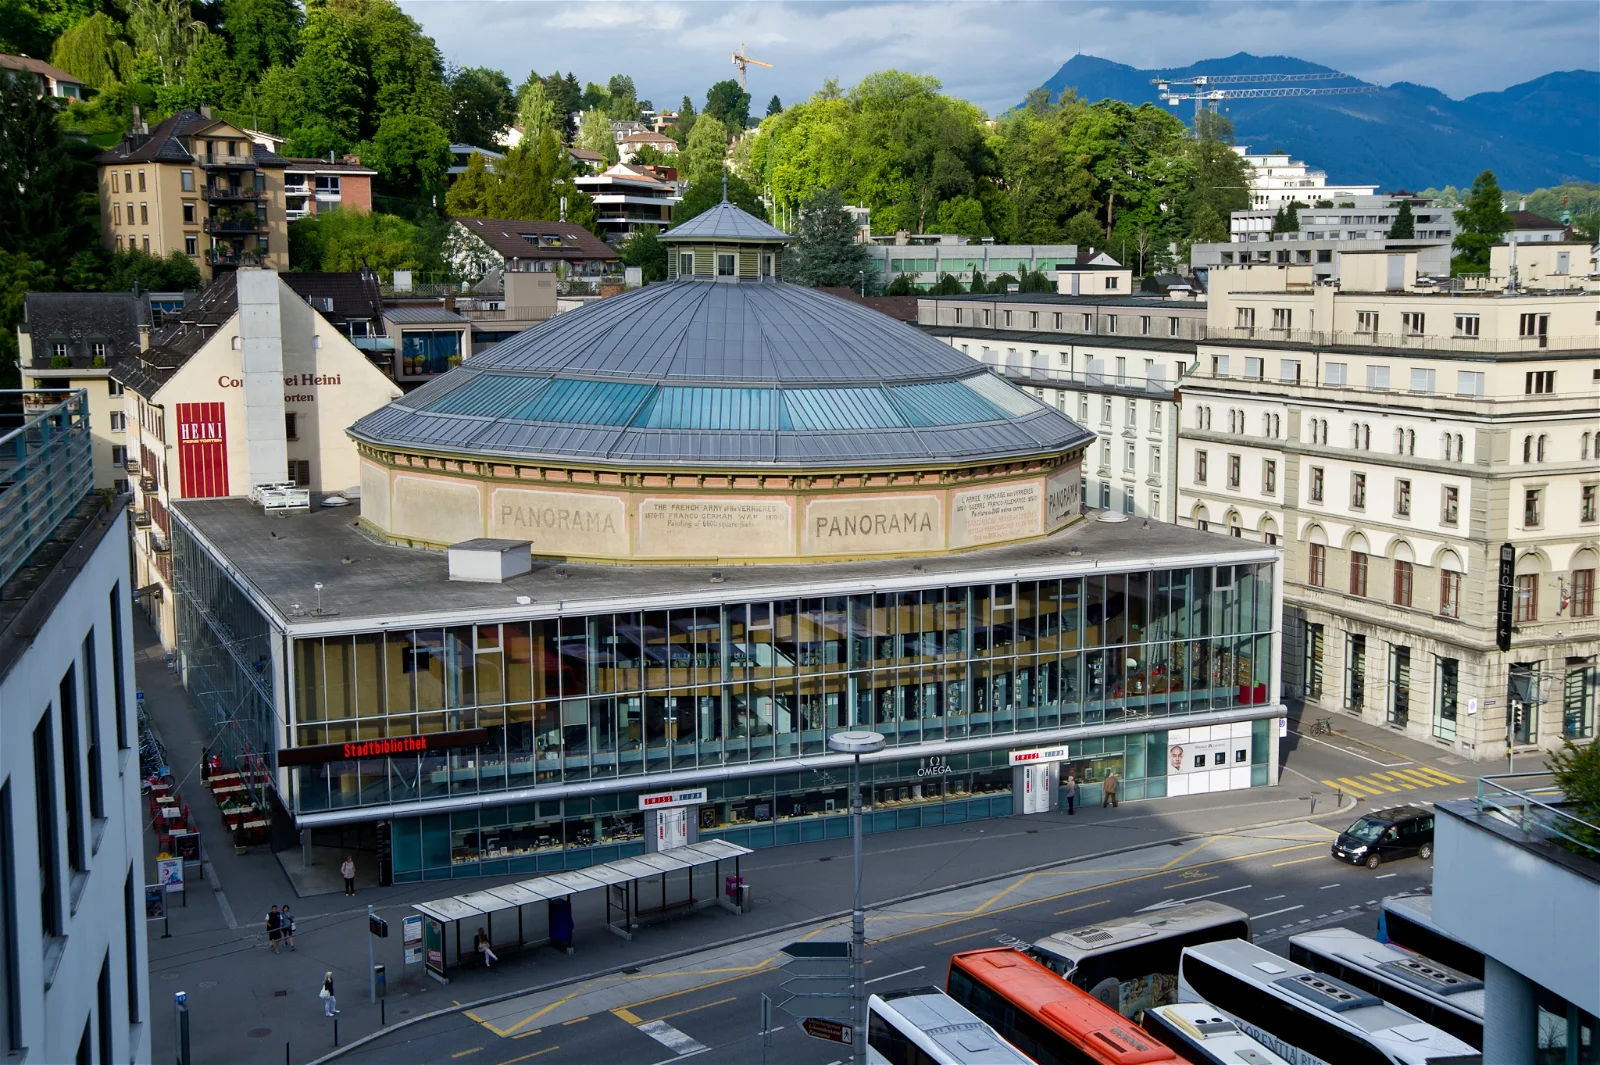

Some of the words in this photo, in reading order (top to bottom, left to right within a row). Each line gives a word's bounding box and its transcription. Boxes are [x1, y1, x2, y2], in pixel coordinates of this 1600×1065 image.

[301, 373, 341, 386] Heini
[284, 393, 314, 403] orten
[181, 422, 222, 440] HEINI
[1048, 482, 1078, 514] PANORAMA
[501, 505, 616, 534] PANORAMA
[667, 520, 692, 528] Painting
[816, 512, 932, 538] PANORAMA
[1500, 564, 1510, 622] HOTEL
[343, 736, 428, 758] Stadtbibliothek
[917, 765, 952, 777] OMEGA
[646, 796, 672, 804] SWISS
[1234, 1018, 1298, 1064] FLORENTIA
